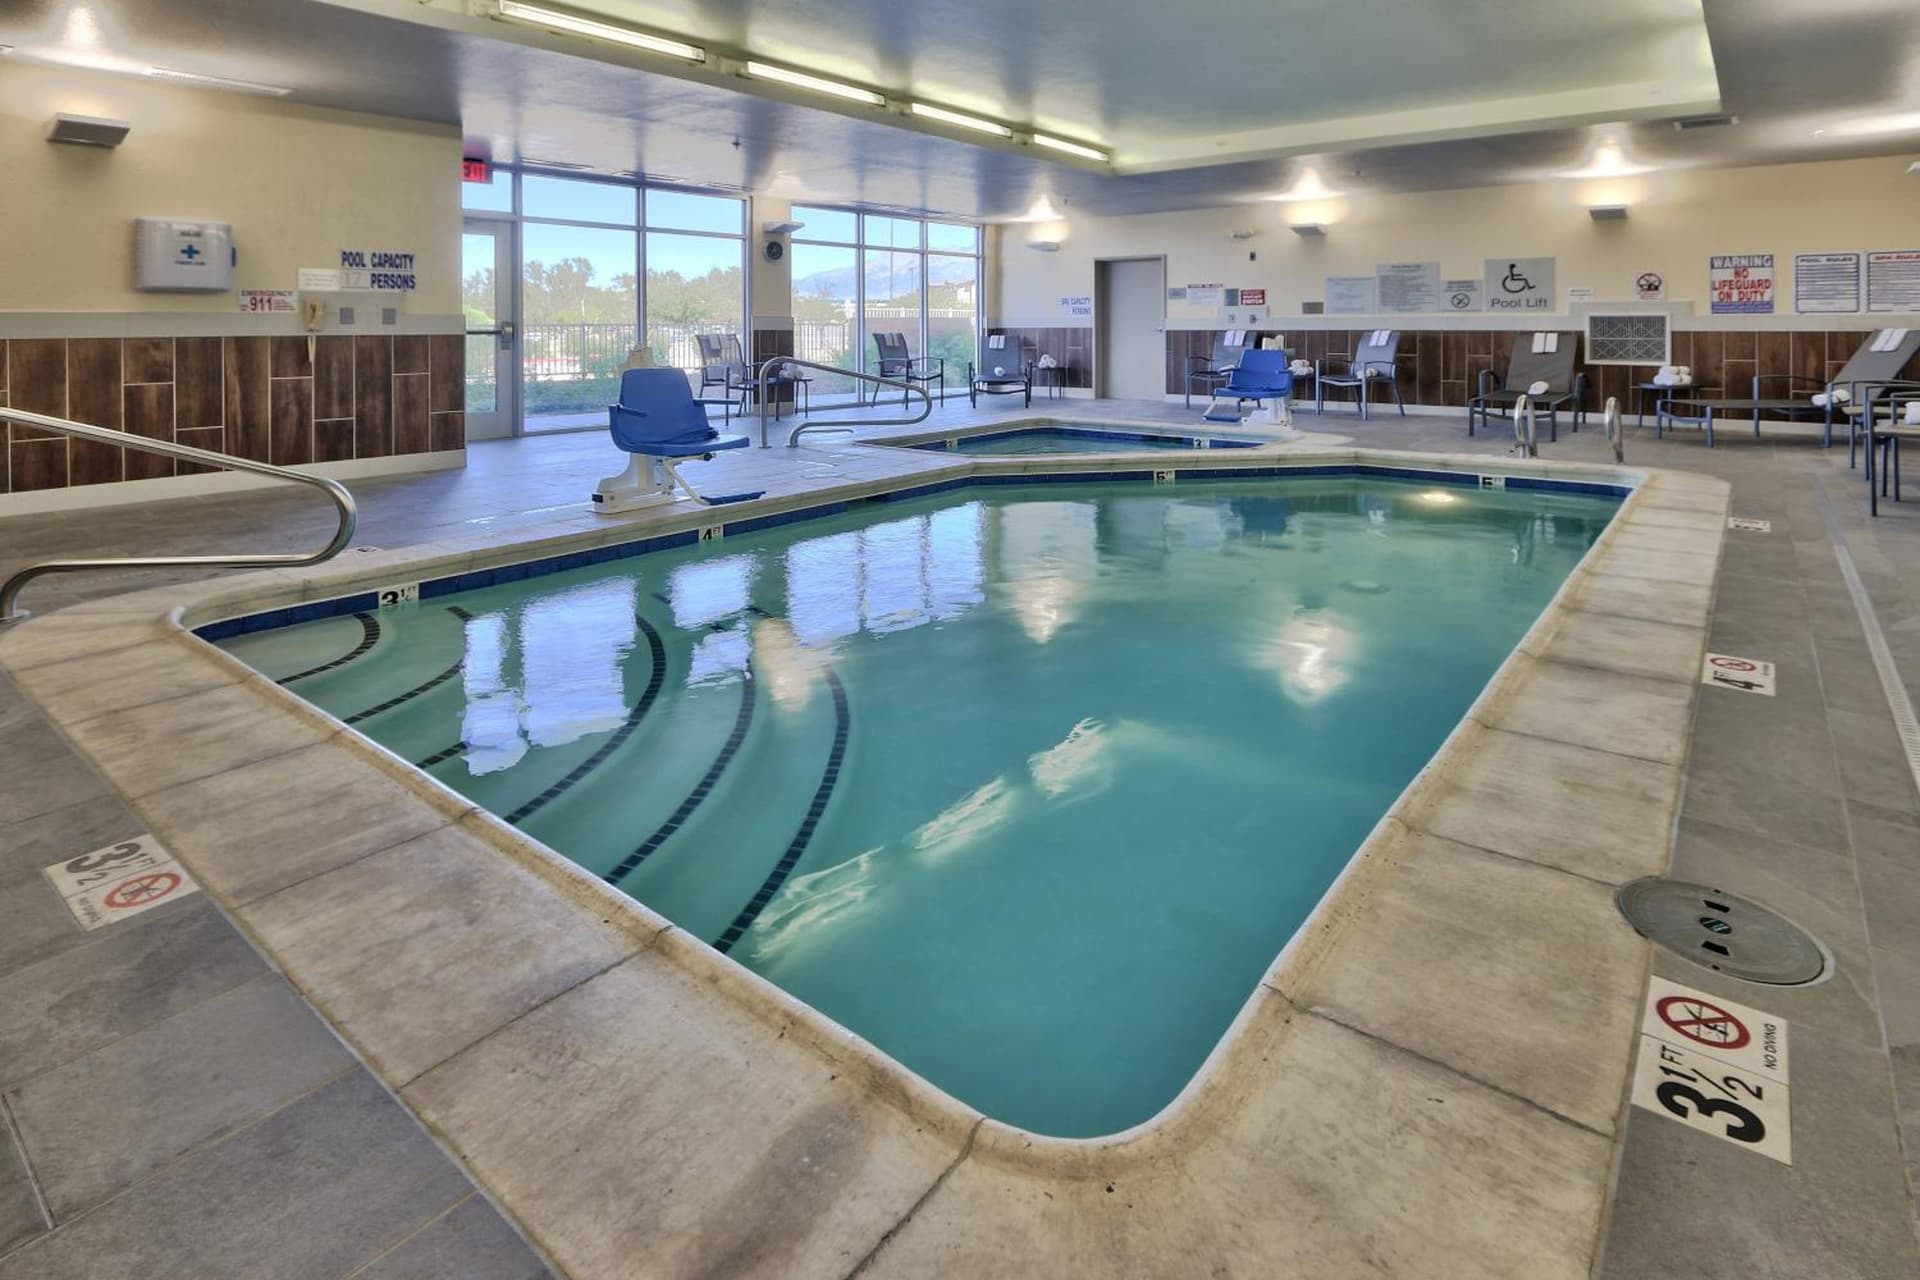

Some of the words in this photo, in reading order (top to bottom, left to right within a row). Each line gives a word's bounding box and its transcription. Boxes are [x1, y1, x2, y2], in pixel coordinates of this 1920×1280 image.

[341, 251, 367, 267] POOL
[371, 253, 415, 269] CAPACITY
[1712, 256, 1771, 268] WARNING
[371, 273, 416, 289] PERSONS
[1734, 268, 1749, 278] NO
[1712, 279, 1771, 291] LIFEGUARD
[250, 297, 272, 311] 911
[1491, 298, 1521, 308] Pool
[1527, 297, 1548, 308] Lift
[1718, 291, 1733, 303] ON
[1738, 290, 1766, 302] DUTY
[66, 843, 142, 873] 3
[1763, 1022, 1777, 1054] DIVING
[1660, 1044, 1684, 1066] FT
[1764, 1053, 1777, 1071] NO
[1656, 1081, 1766, 1144] 3
